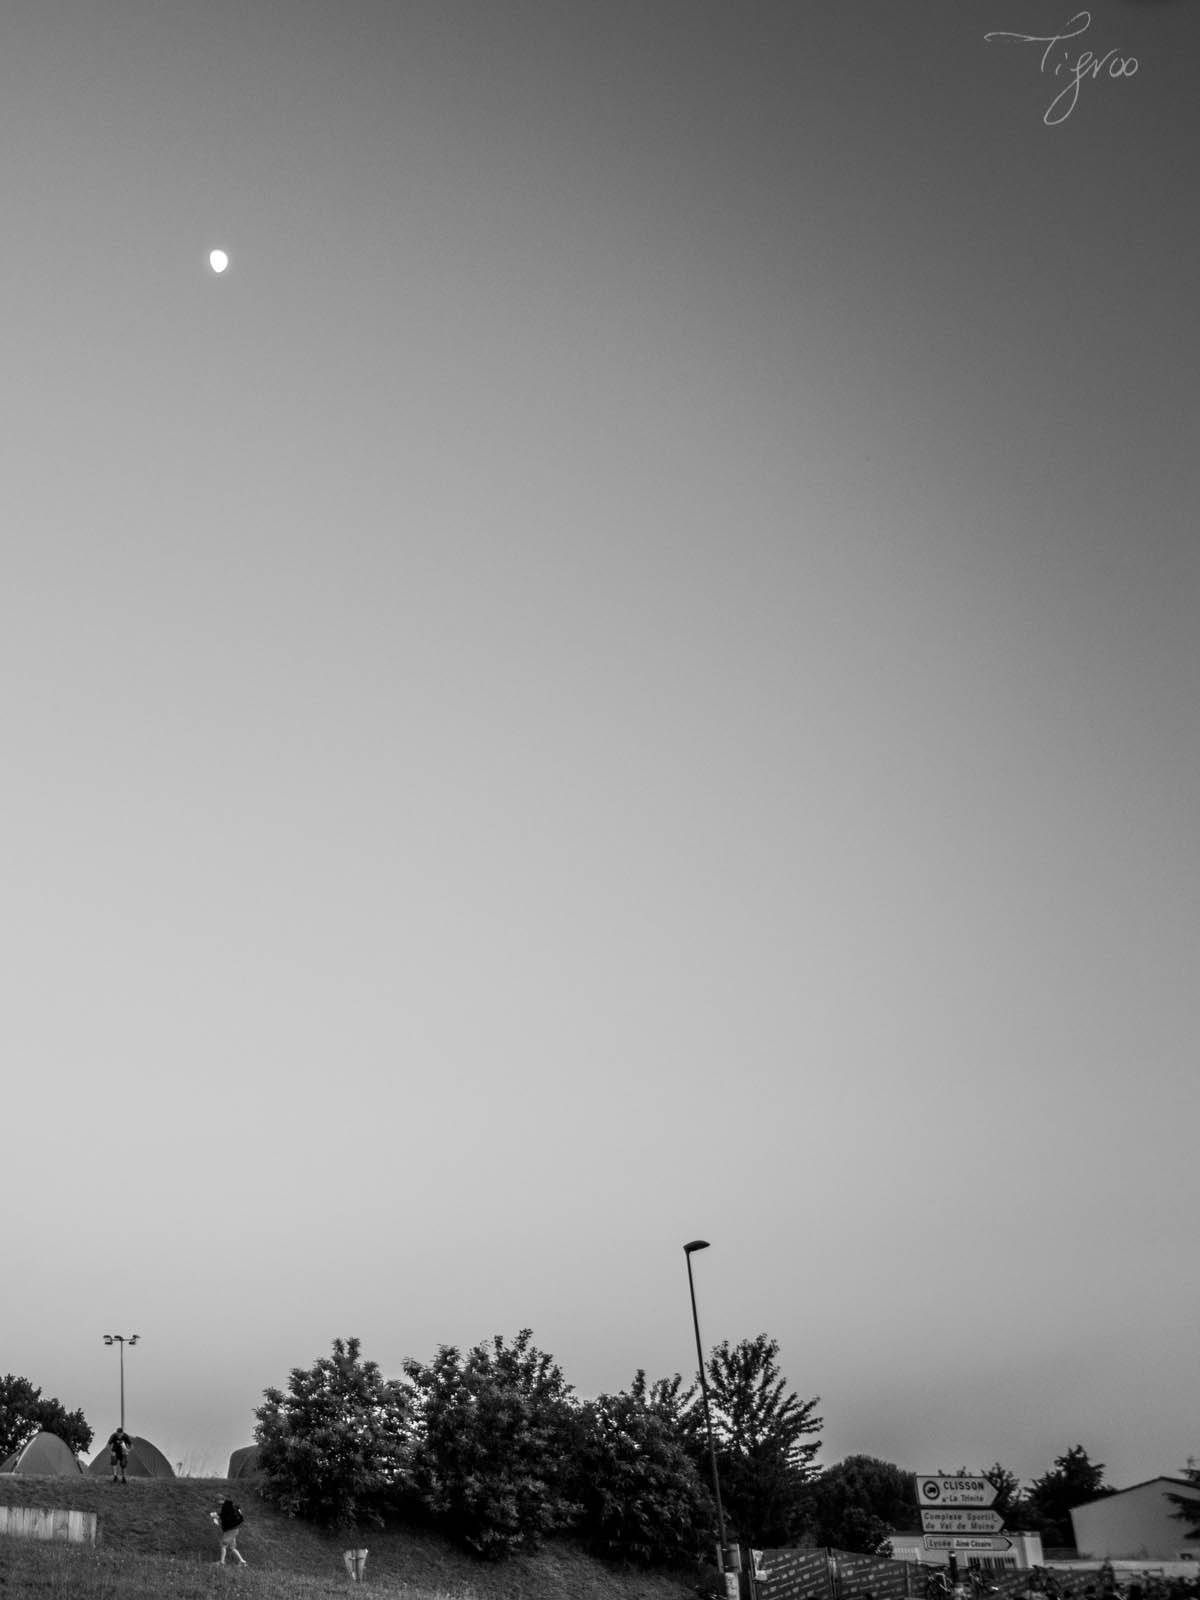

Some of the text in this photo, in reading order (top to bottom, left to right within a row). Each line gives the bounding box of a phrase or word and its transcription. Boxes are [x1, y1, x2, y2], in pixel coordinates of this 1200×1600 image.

[943, 1481, 984, 1490] CLISSON
[949, 1494, 958, 1502] La
[924, 1512, 962, 1521] Complexe
